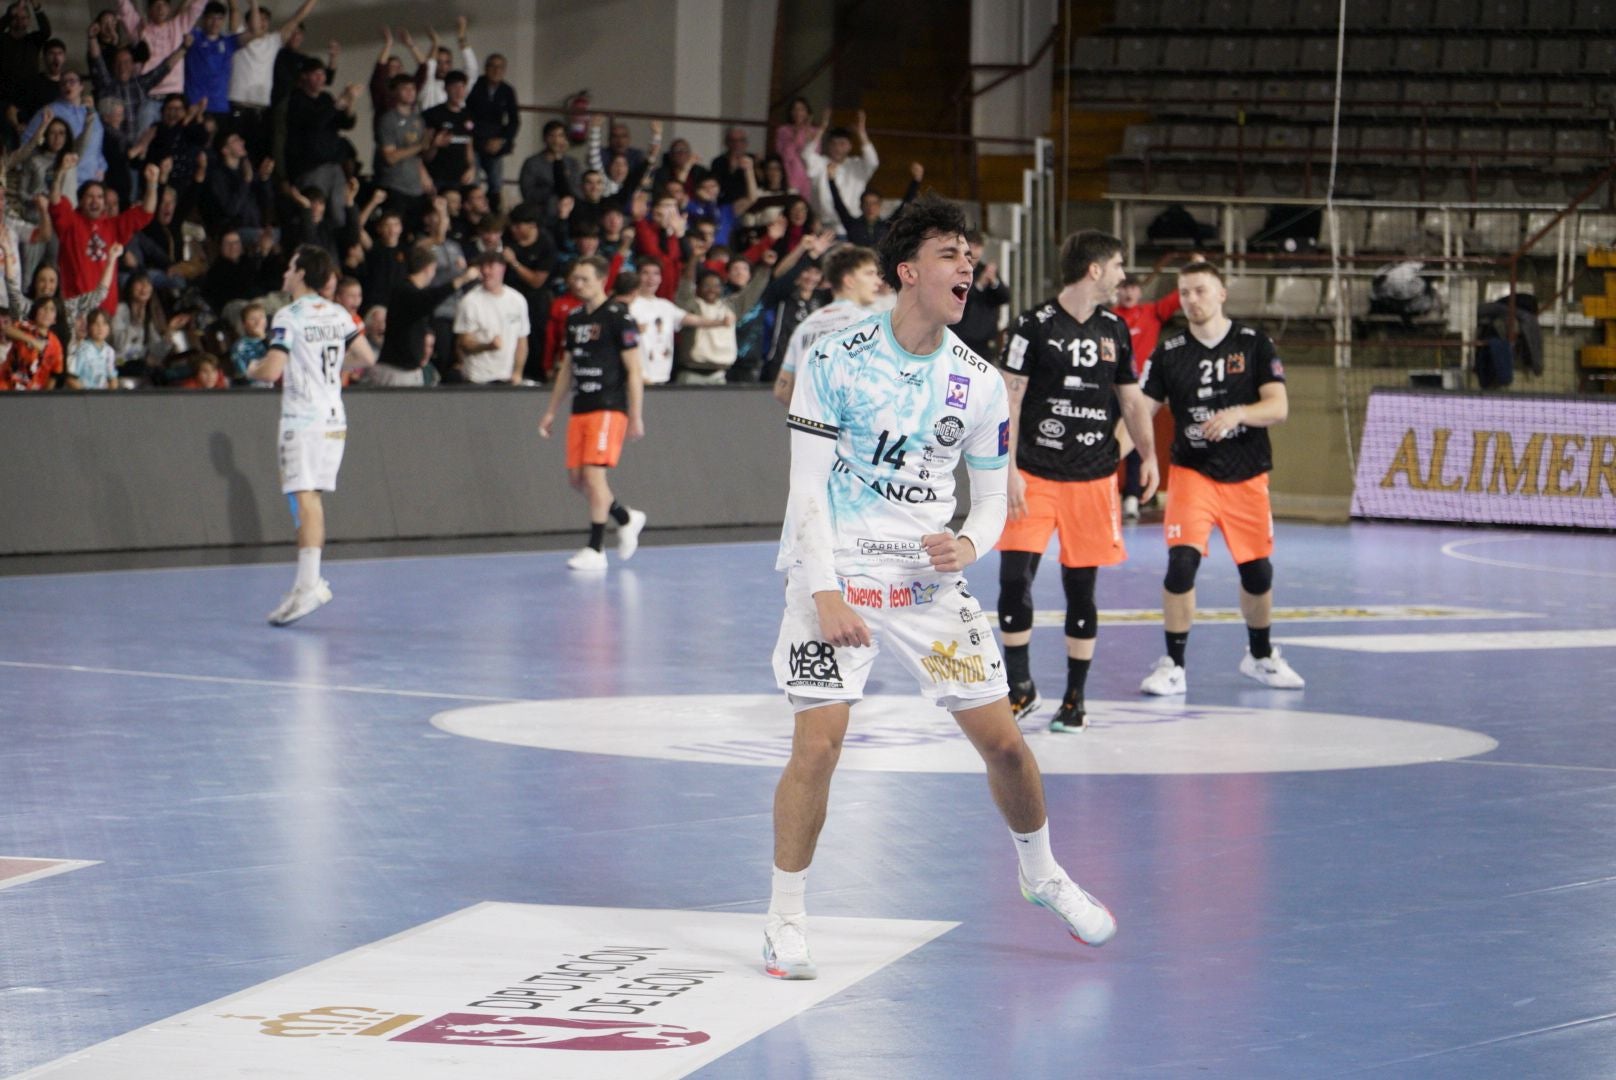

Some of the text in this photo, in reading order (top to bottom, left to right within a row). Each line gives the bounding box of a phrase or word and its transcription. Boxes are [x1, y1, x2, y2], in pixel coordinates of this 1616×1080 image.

[952, 344, 988, 373] alsa
[1067, 338, 1098, 368] 13
[1199, 358, 1225, 385] 21
[872, 430, 908, 470] 14
[1380, 427, 1616, 498] ALIMER
[858, 480, 937, 503] ANCA
[862, 541, 916, 550] CARRERO
[1168, 524, 1181, 539] 21
[847, 579, 912, 609] huevos león
[789, 640, 835, 662] MOR
[789, 659, 843, 682] VEGA
[467, 945, 669, 1010] DIPUTACIÓN
[567, 967, 725, 1015] DE LEÓN
